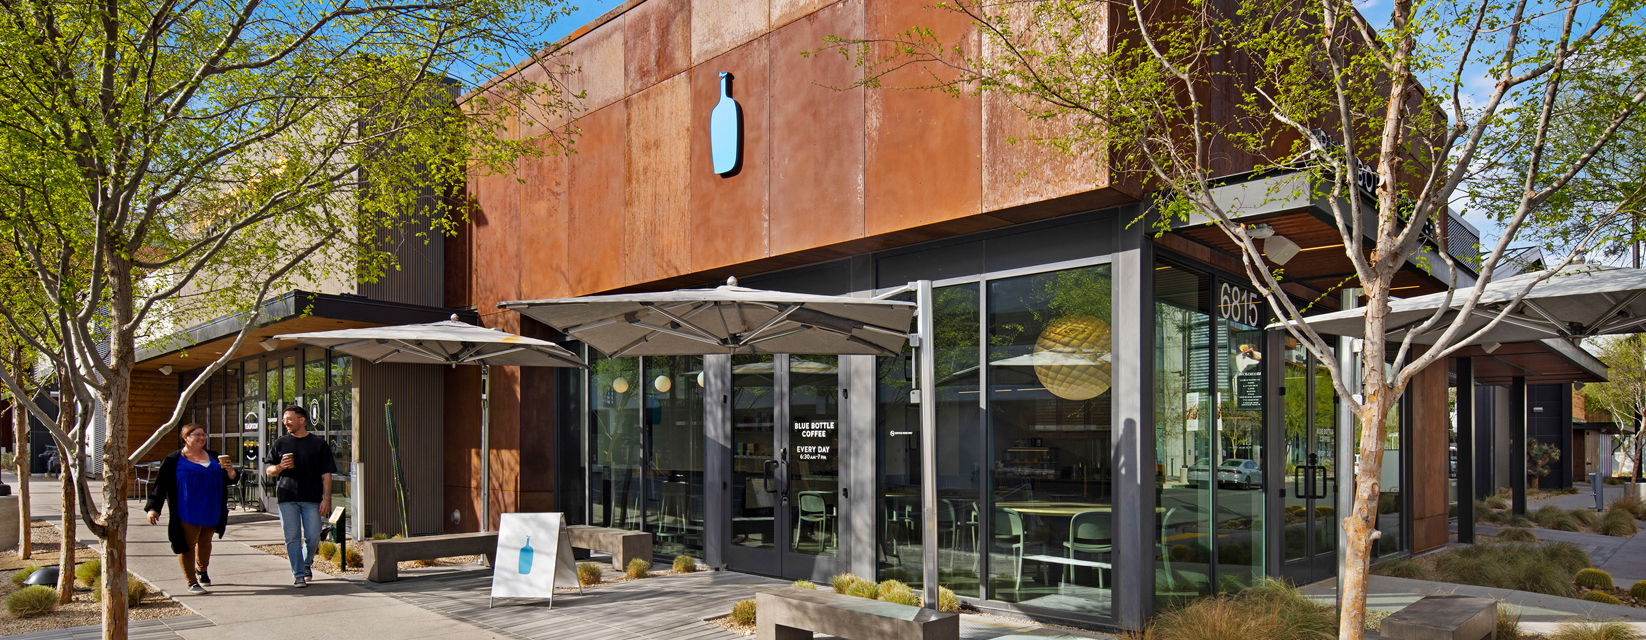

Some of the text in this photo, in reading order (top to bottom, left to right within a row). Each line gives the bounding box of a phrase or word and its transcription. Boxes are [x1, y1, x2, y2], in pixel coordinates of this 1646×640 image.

[1221, 282, 1258, 327] 6815
[802, 430, 826, 438] COFFEE
[796, 445, 830, 453] EVERY DAY
